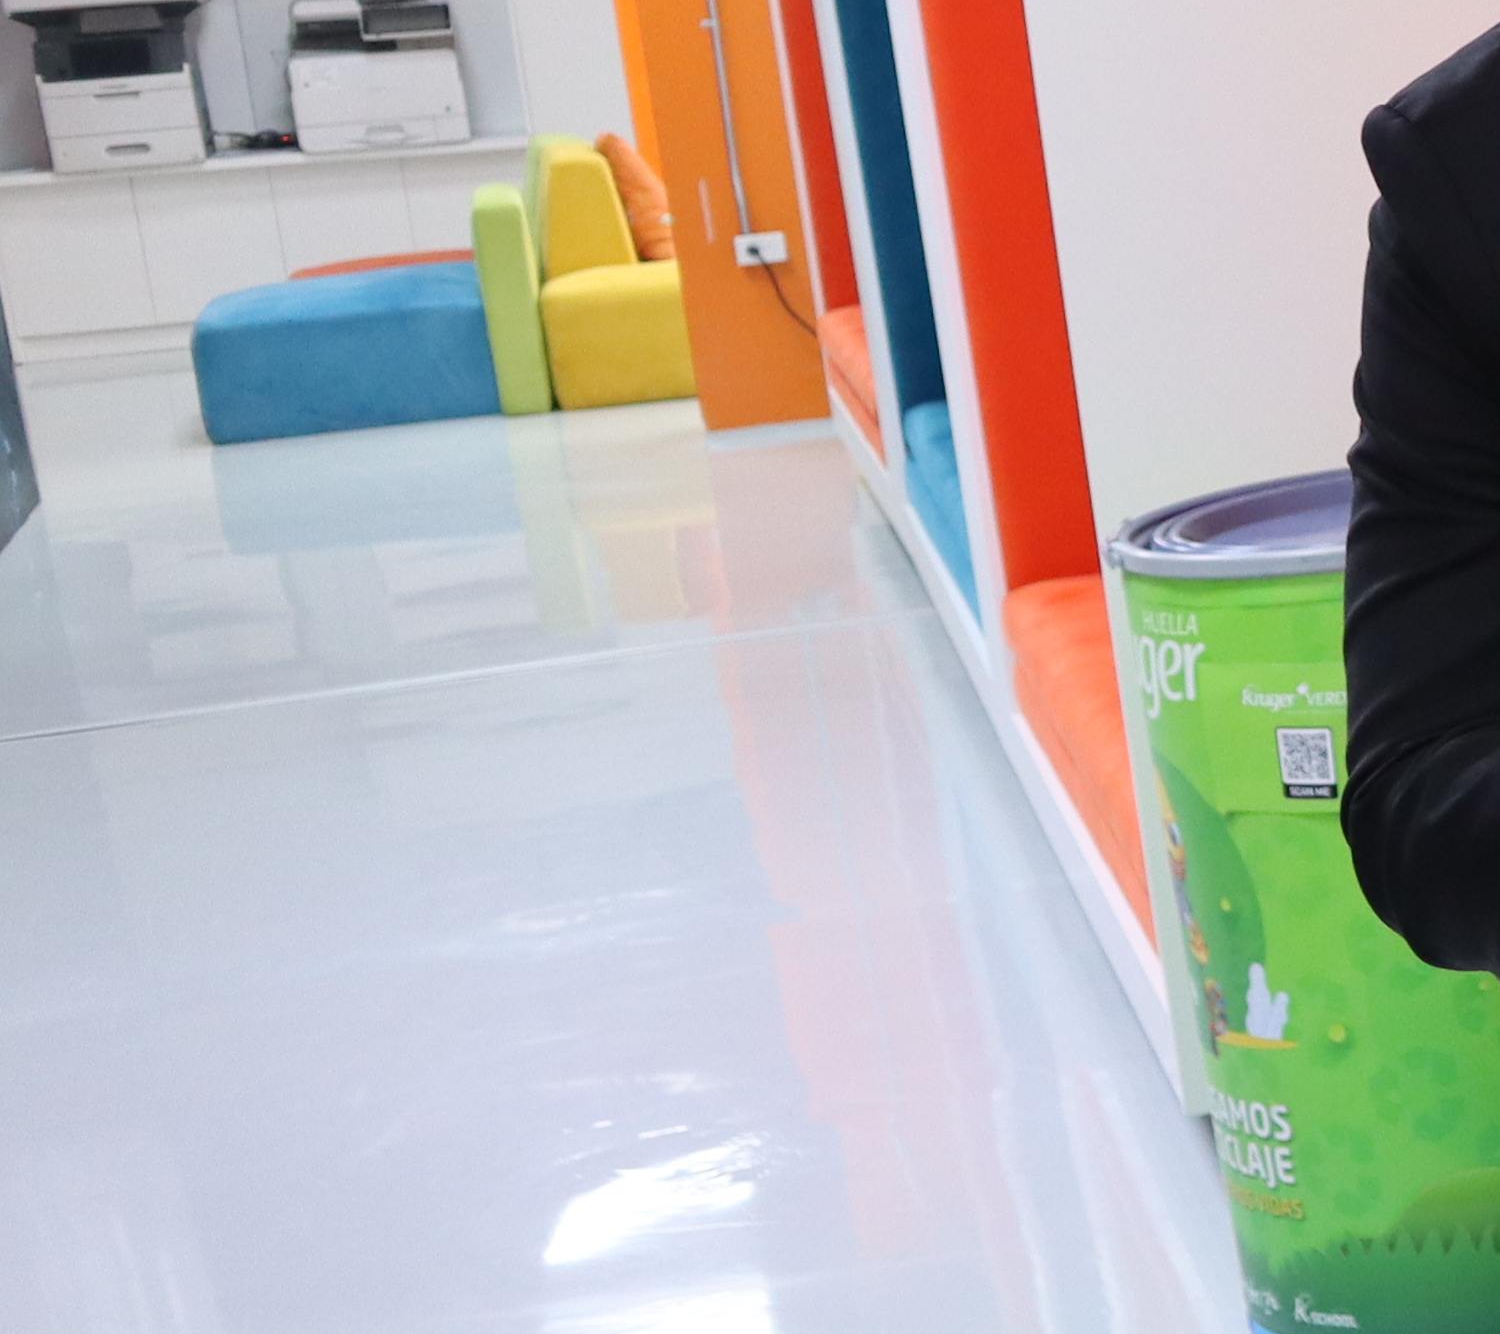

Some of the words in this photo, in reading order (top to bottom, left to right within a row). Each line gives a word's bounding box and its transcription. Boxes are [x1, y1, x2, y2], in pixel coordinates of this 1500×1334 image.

[1143, 611, 1198, 636] HUELLA
[1134, 635, 1206, 720] ger
[1241, 684, 1295, 712] Kruger
